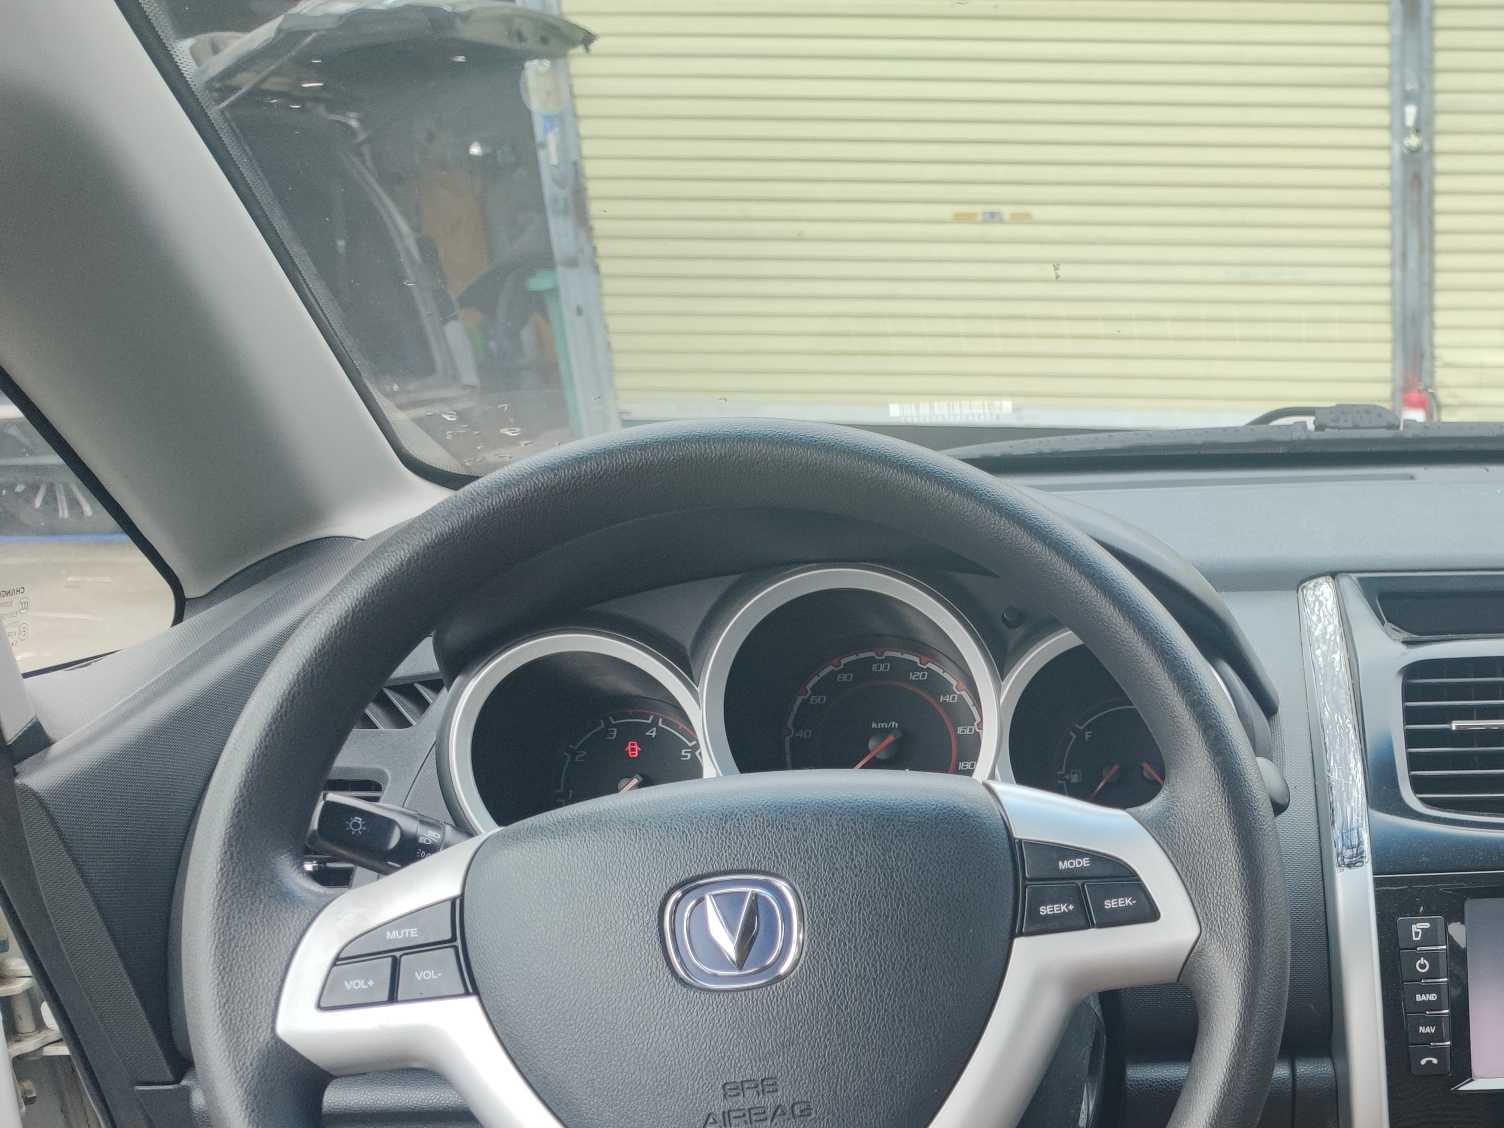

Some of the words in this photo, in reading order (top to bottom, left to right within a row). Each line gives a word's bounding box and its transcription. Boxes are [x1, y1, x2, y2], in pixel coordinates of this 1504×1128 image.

[871, 663, 890, 672] 100
[836, 673, 853, 682] 80
[909, 671, 928, 681] 120
[939, 695, 958, 703] 140
[871, 720, 899, 729] km/h
[957, 725, 975, 735] 160
[605, 728, 617, 740] 3
[645, 727, 657, 739] 4
[1084, 731, 1093, 742] F
[575, 750, 587, 762] 2
[681, 749, 692, 761] 5
[958, 760, 976, 770] 180
[1058, 857, 1091, 870] MODE
[1103, 896, 1137, 909] SEEK-
[1039, 903, 1075, 916] SEEK+
[385, 927, 419, 940] MUTE
[414, 969, 443, 980] VOL-
[344, 979, 375, 990] VOL+
[1415, 993, 1438, 1002] BAND
[1418, 1025, 1436, 1034] NAV
[721, 1077, 780, 1100] SRS
